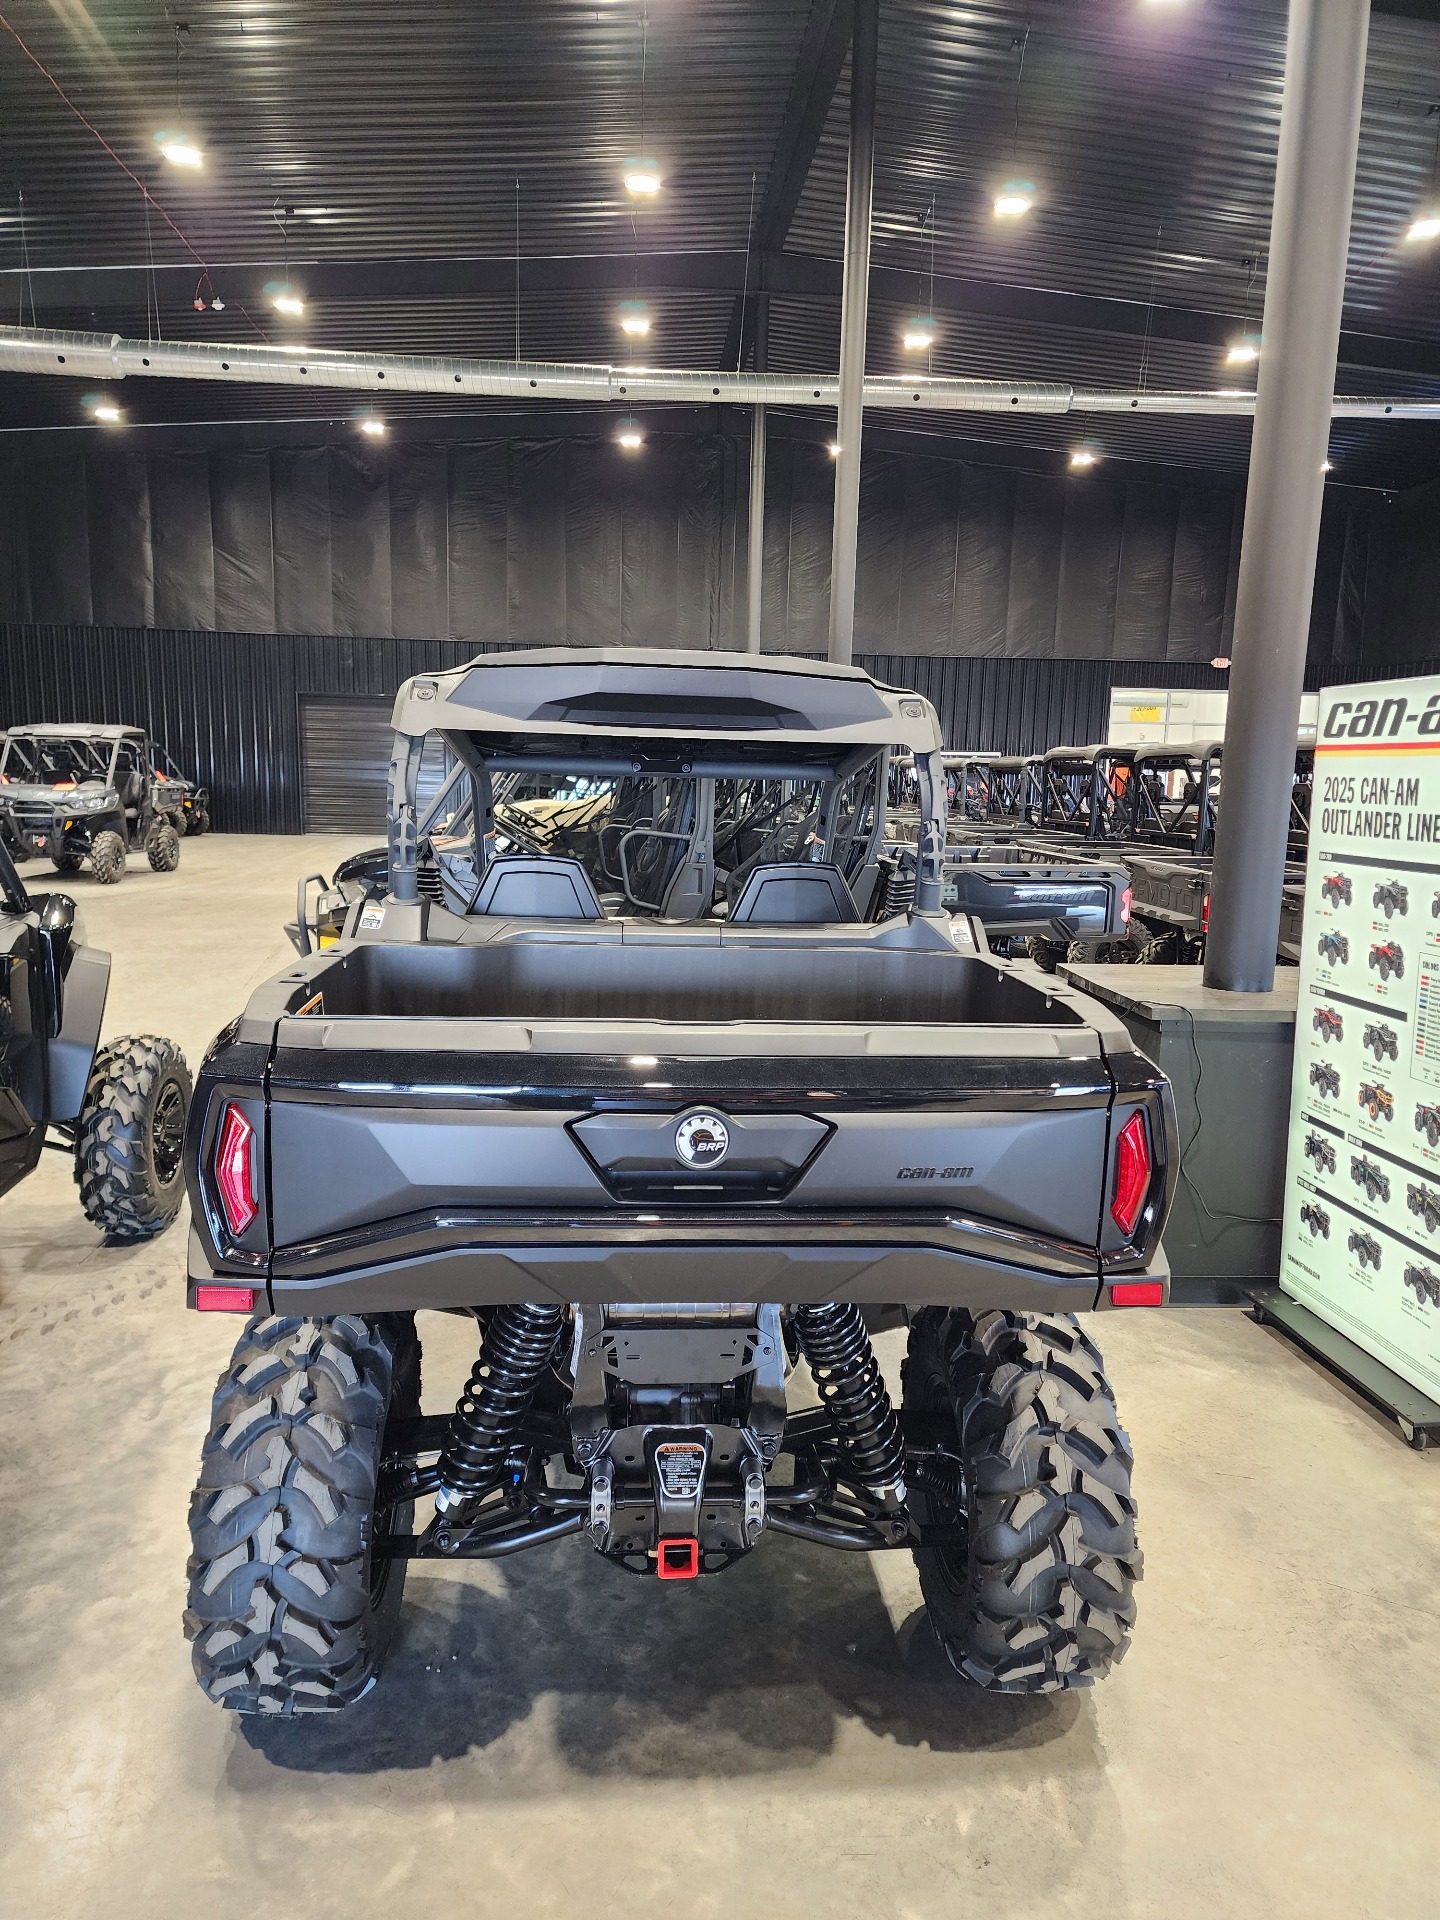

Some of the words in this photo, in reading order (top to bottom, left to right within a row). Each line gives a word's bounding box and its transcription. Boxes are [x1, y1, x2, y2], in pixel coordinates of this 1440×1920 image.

[1323, 776, 1356, 803] 2025
[1360, 777, 1420, 806] CAN-AM
[1321, 807, 1401, 840] OUTLANDER
[696, 1142, 725, 1152] BRP
[896, 1166, 974, 1179] can-am
